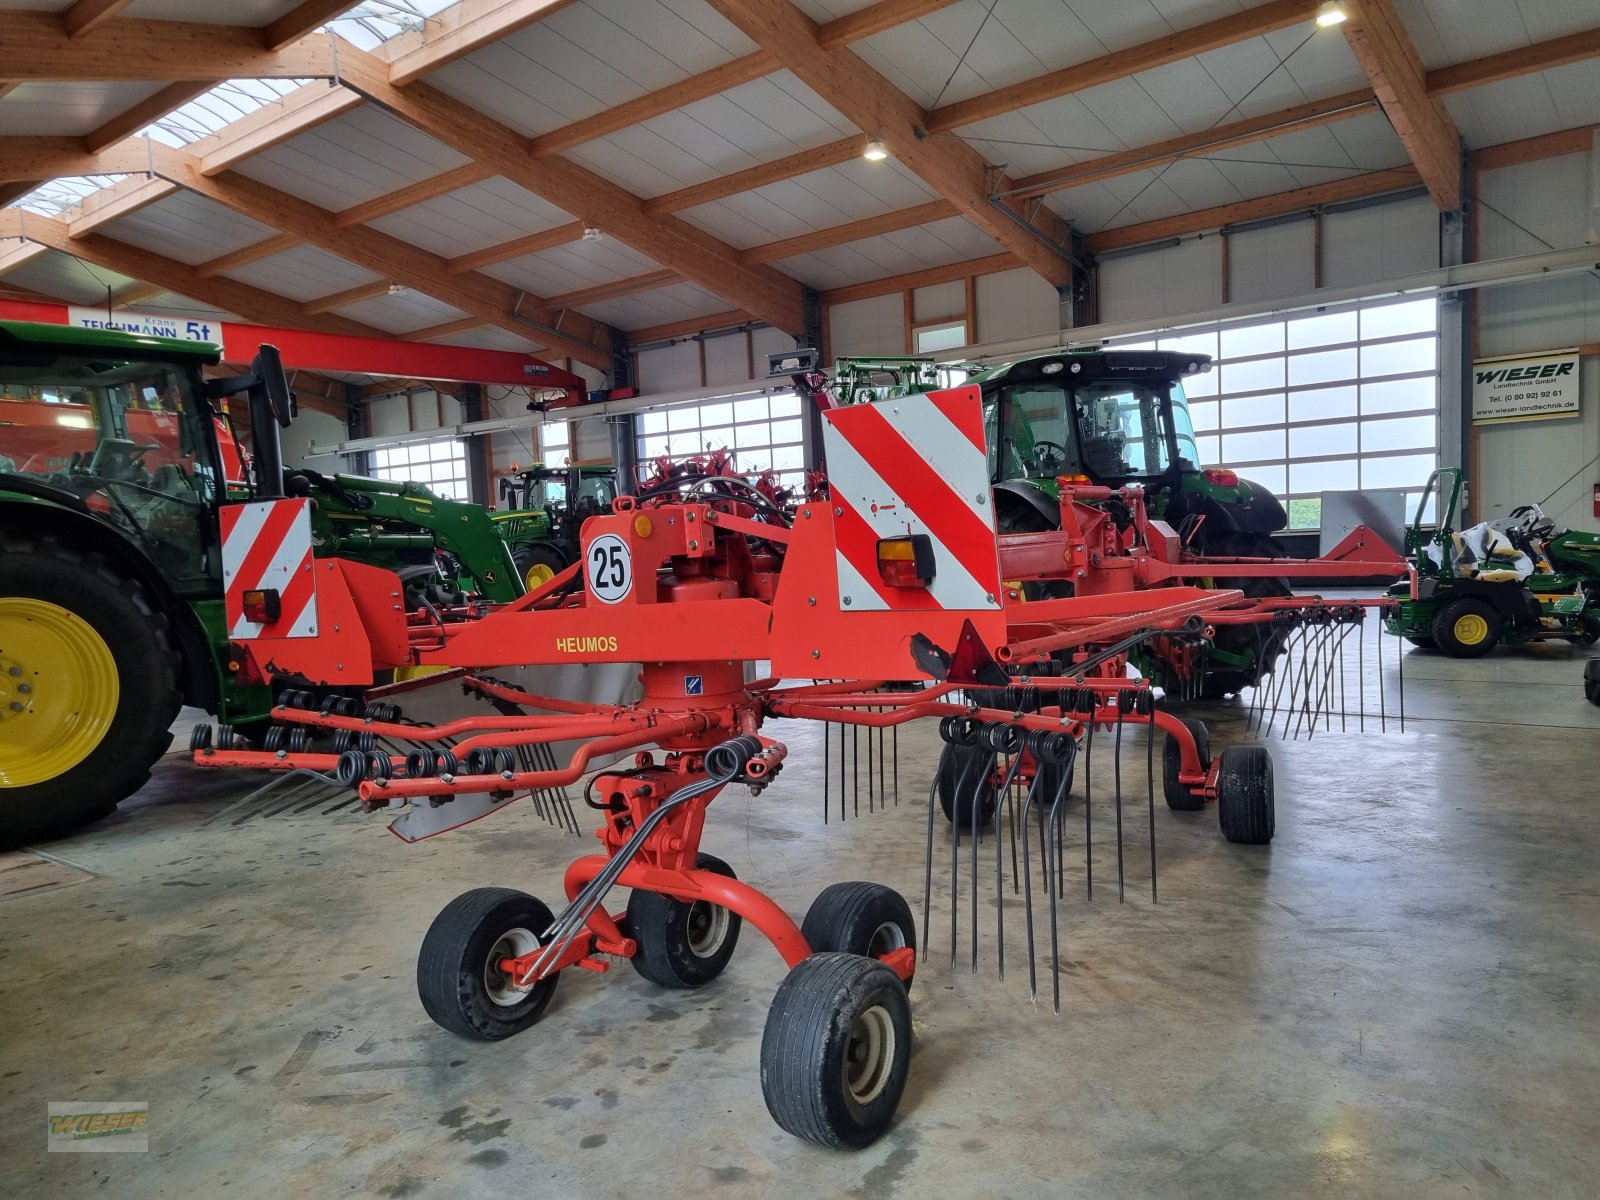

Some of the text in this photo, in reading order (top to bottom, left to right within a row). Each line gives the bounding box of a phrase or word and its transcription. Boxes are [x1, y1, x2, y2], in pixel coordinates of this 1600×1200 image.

[145, 317, 176, 327] Krane
[1475, 362, 1575, 384] WIESER
[1493, 381, 1534, 390] Landtechnik
[1504, 395, 1512, 403] (0
[1526, 392, 1539, 400] 92)
[1476, 402, 1575, 416] www.wieser-landtechnik.de
[593, 545, 625, 588] 25
[556, 636, 618, 653] HEUMOS
